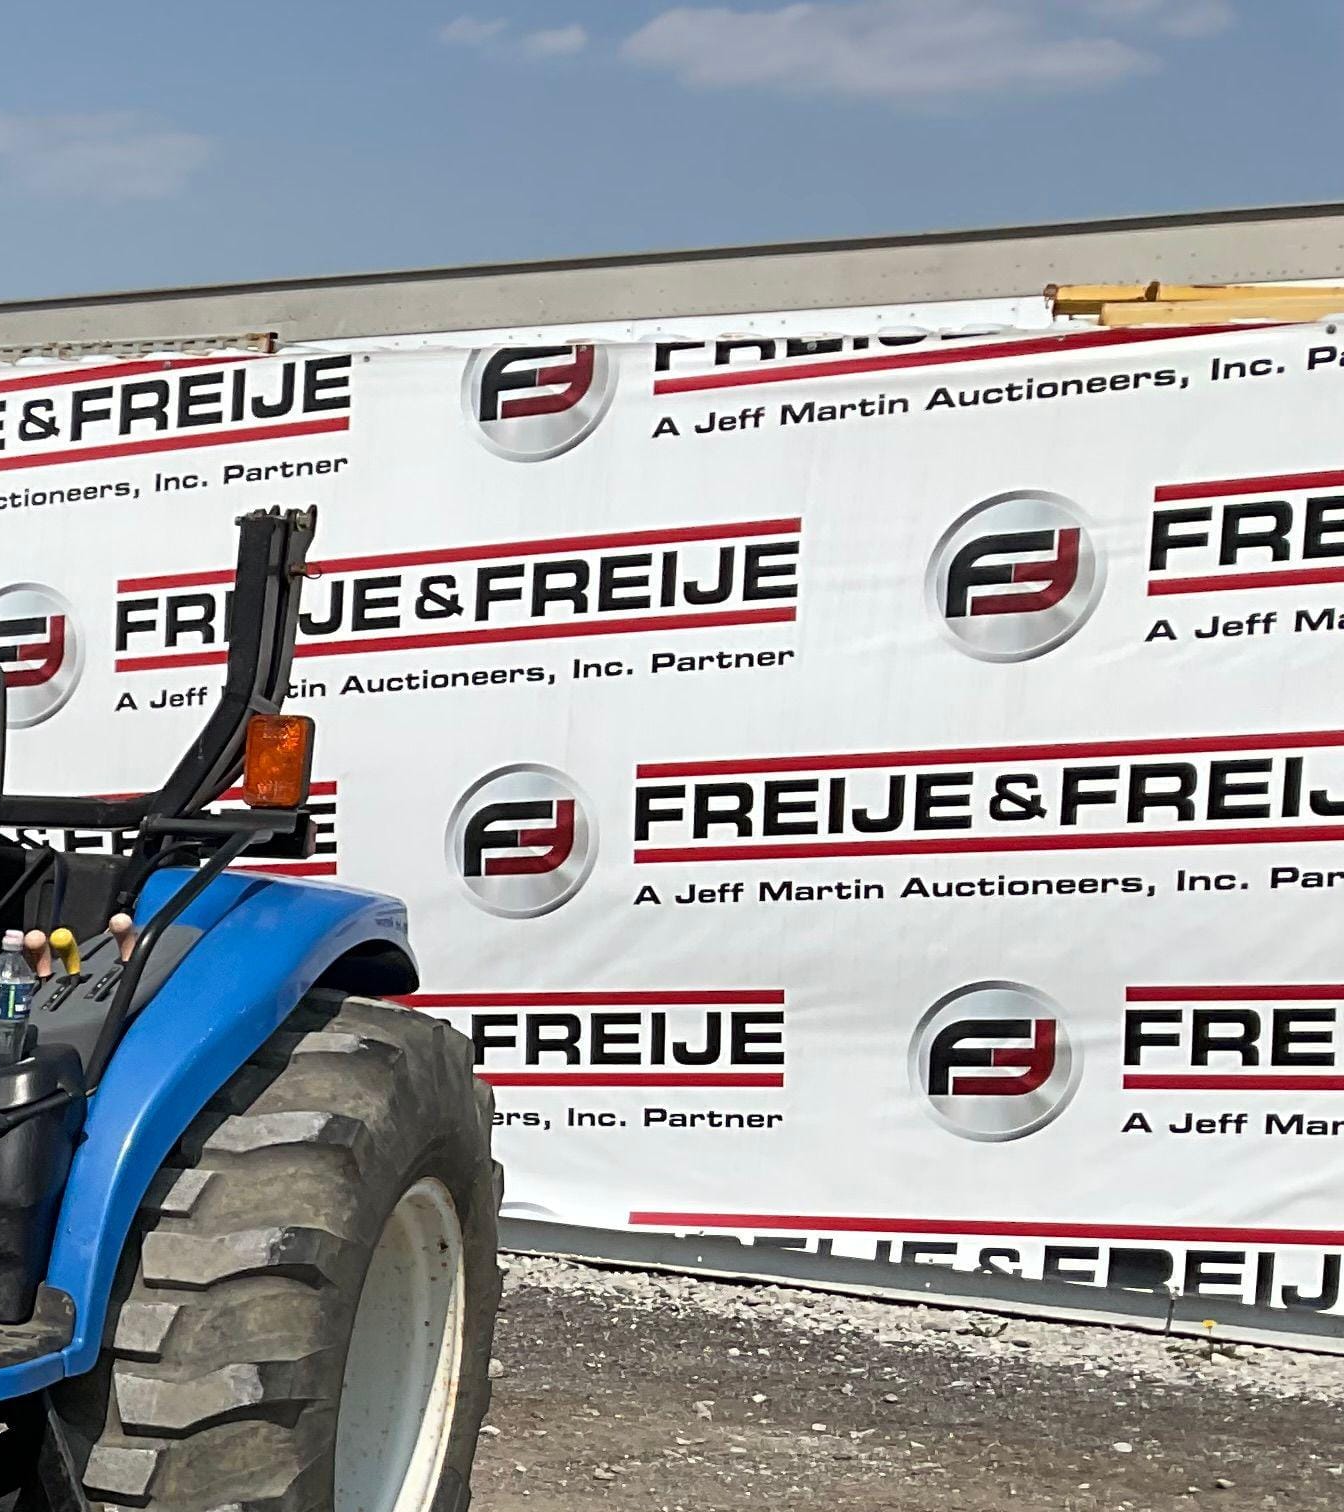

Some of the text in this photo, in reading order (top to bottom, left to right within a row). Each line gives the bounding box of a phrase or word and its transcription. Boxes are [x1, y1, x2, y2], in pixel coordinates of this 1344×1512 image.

[18, 398, 60, 441] &
[69, 354, 352, 442] FREIJE
[651, 417, 680, 439] A
[695, 406, 766, 434] Jeff
[780, 394, 909, 426] Martin
[925, 368, 1190, 411] Auctioneers,
[1211, 358, 1285, 381] Inc.
[155, 473, 208, 492] Inc.
[223, 457, 348, 485] Partner
[115, 540, 800, 652] FRJE & FREIJE
[1145, 619, 1178, 642] A
[1194, 611, 1278, 639] Jeff
[114, 692, 139, 712] A
[150, 686, 208, 710] Jeff
[339, 666, 556, 696] Auctioneers,
[573, 659, 634, 680] Inc.
[651, 650, 795, 674] Partner
[634, 772, 974, 842] FREIJE
[989, 773, 1047, 822] &
[633, 885, 662, 906] A
[675, 882, 745, 905] Jeff
[759, 878, 884, 902] Martin
[900, 874, 1156, 898] Auctioneers,
[1177, 870, 1249, 892] Inc.
[471, 1011, 785, 1066] FREIJE
[567, 1108, 627, 1127] Inc.
[643, 1108, 784, 1128] Partner
[1121, 1112, 1153, 1133] A
[1169, 1113, 1249, 1134] Jeff
